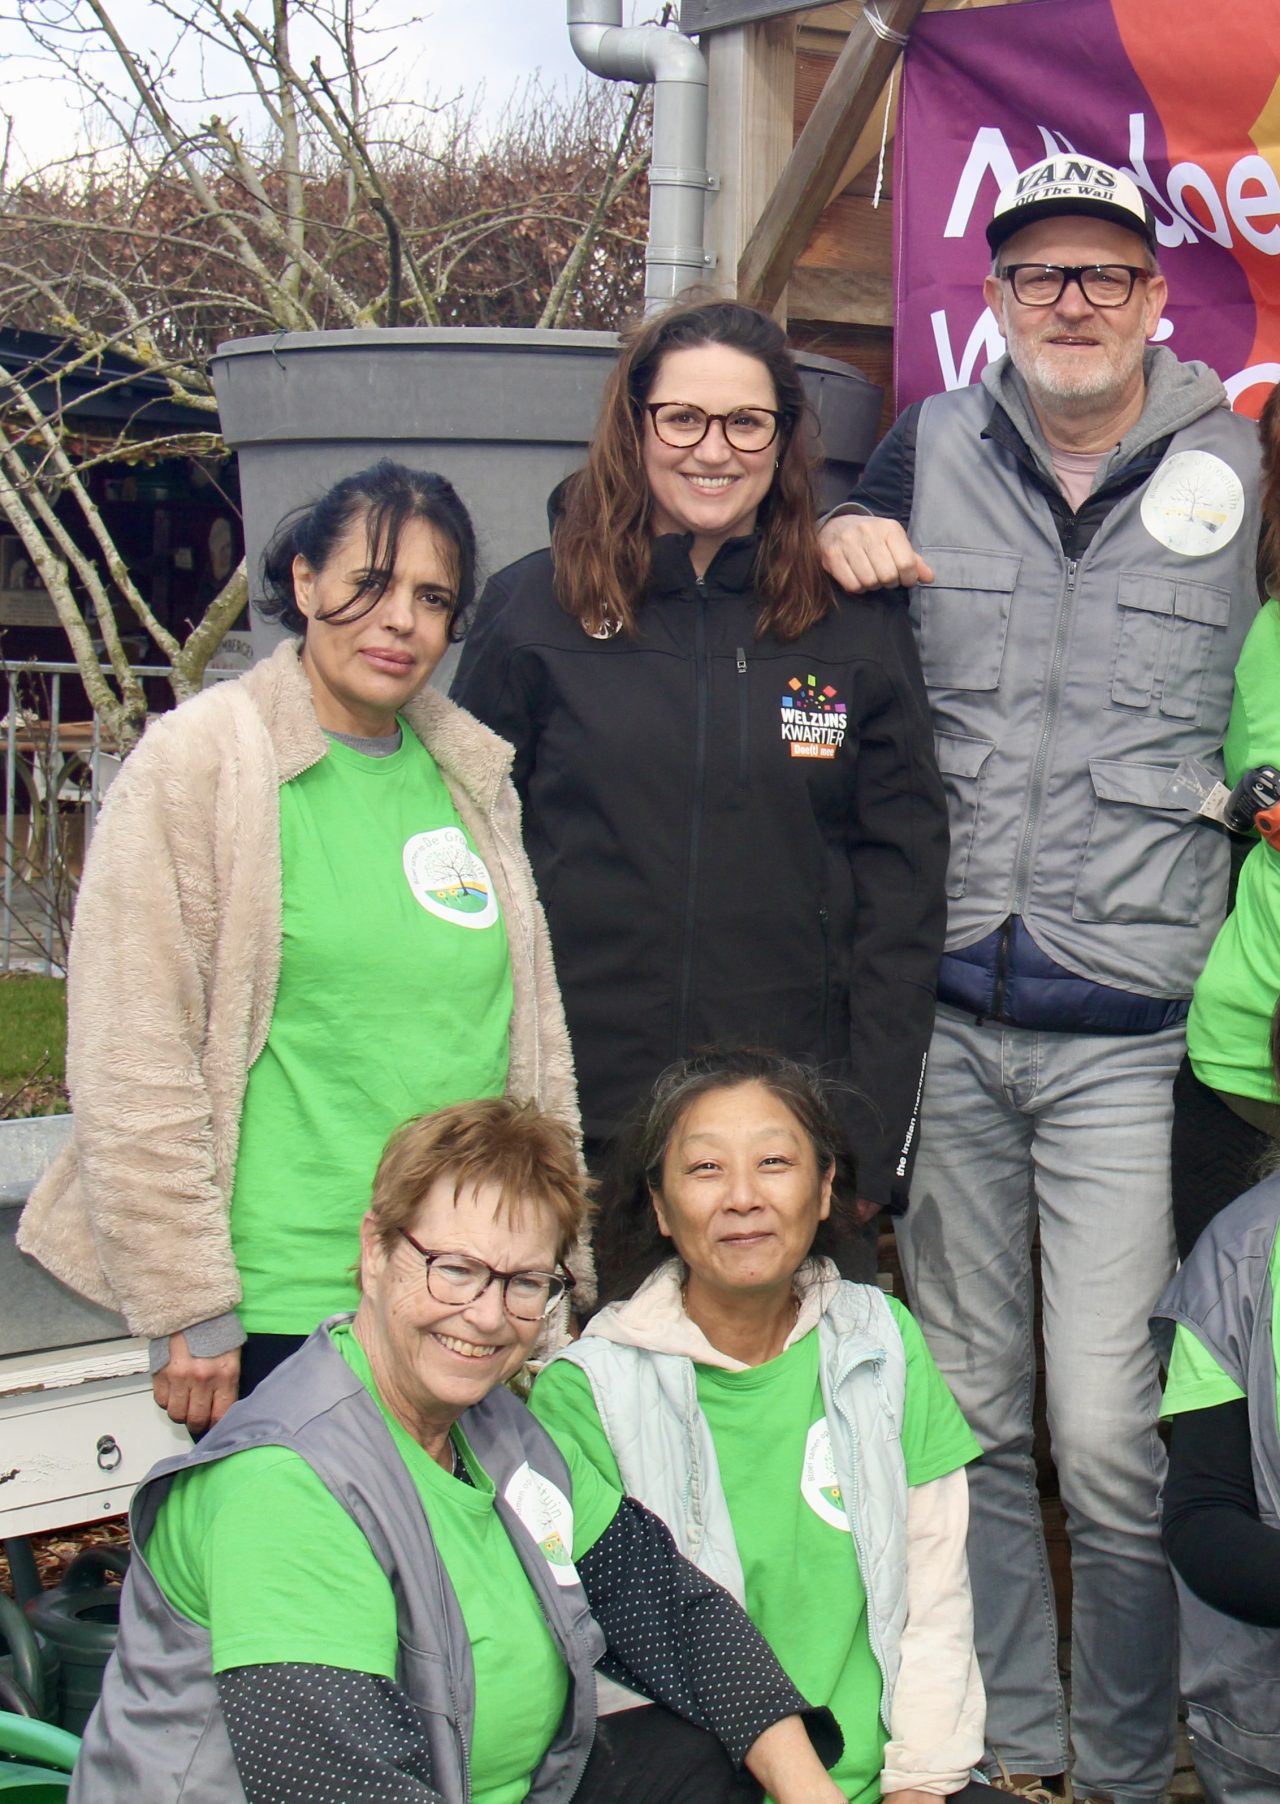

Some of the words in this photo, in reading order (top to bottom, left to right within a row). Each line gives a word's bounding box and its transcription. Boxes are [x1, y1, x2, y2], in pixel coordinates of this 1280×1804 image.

[1015, 161, 1117, 196] VANS
[1042, 186, 1072, 198] The
[1077, 186, 1113, 200] Wall
[781, 707, 847, 730] WELZIJNS
[781, 723, 845, 748] KWARTIER
[896, 1156, 908, 1177] the
